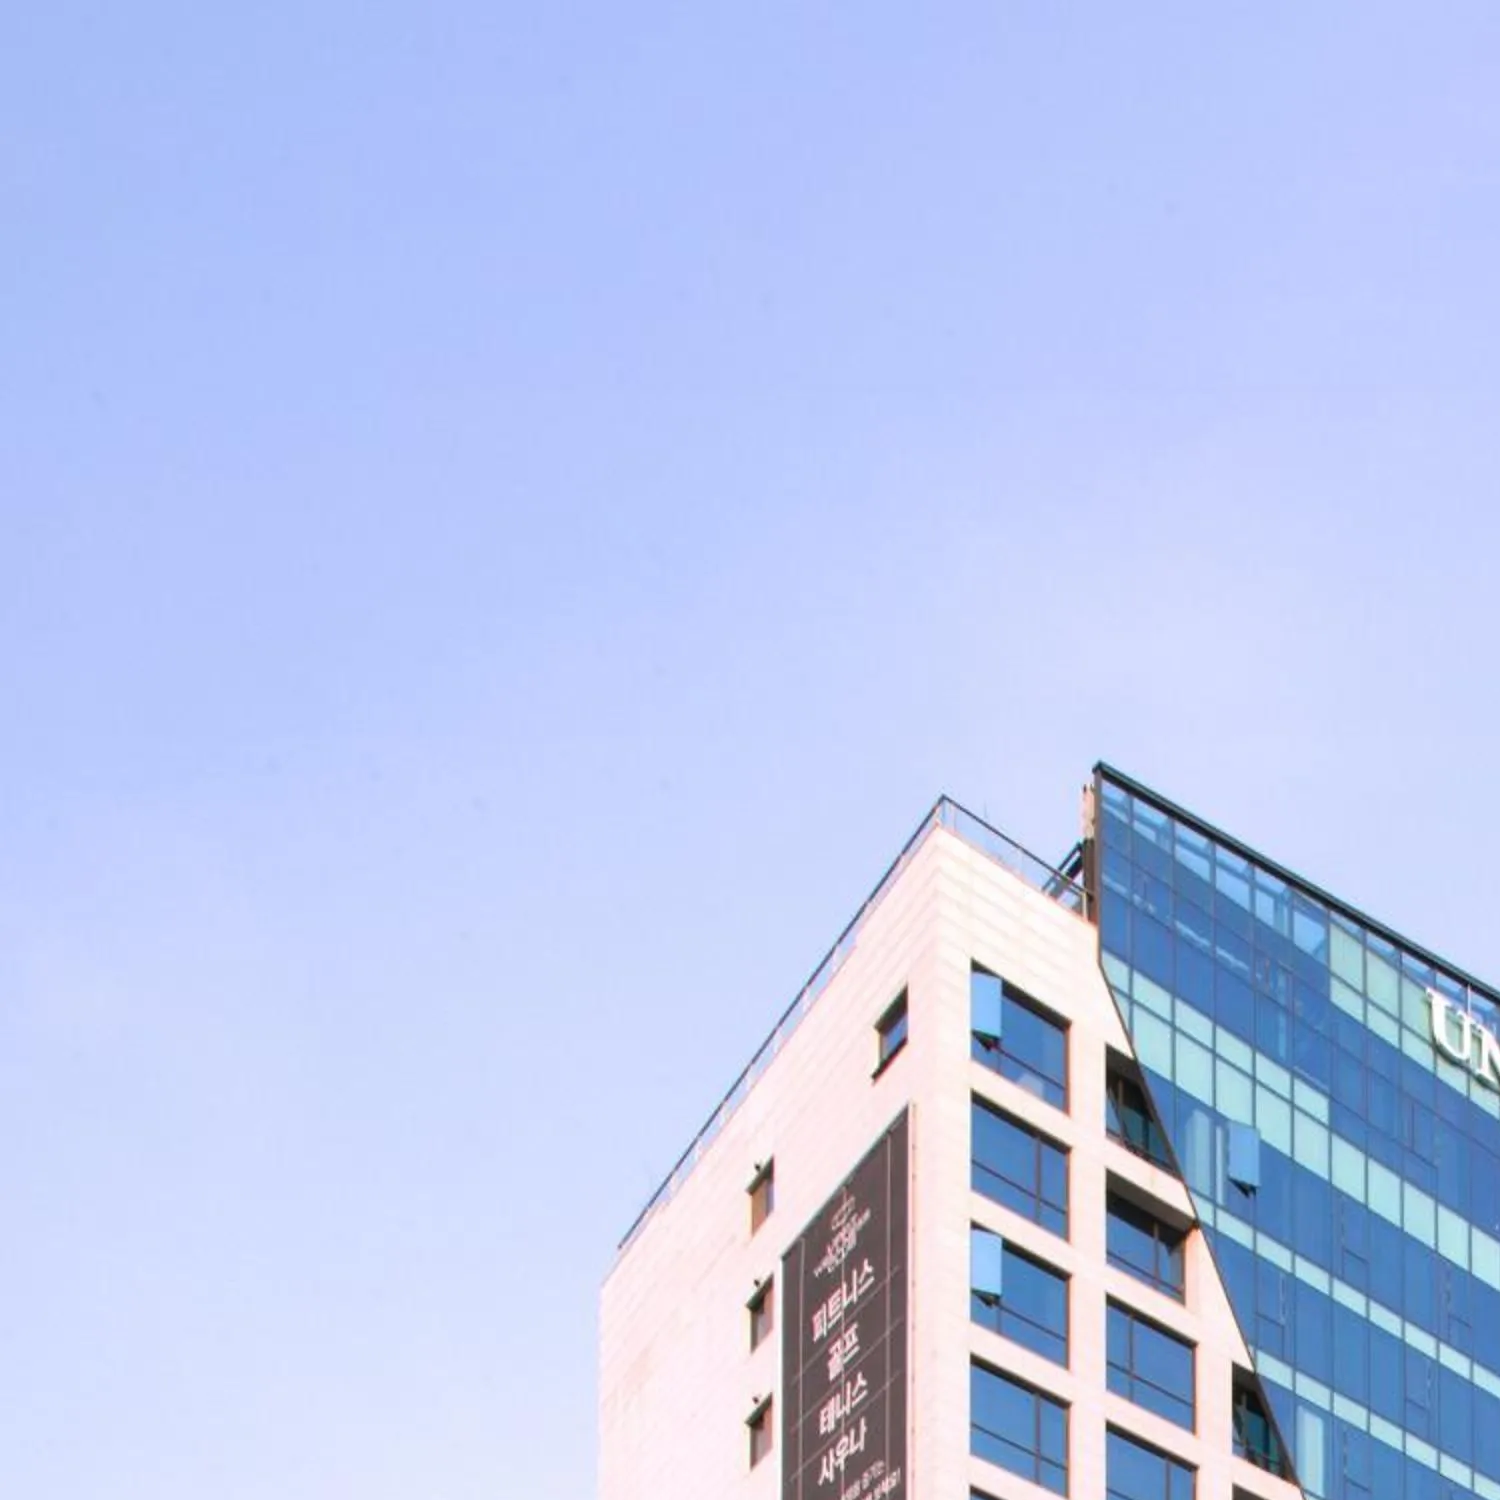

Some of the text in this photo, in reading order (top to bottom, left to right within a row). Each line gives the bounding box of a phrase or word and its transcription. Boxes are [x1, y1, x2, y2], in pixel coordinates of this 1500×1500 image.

[811, 1258, 876, 1343] 피트니스
[827, 1322, 861, 1381] 골프
[819, 1371, 868, 1434] 테니스
[817, 1417, 868, 1487] 사우나
